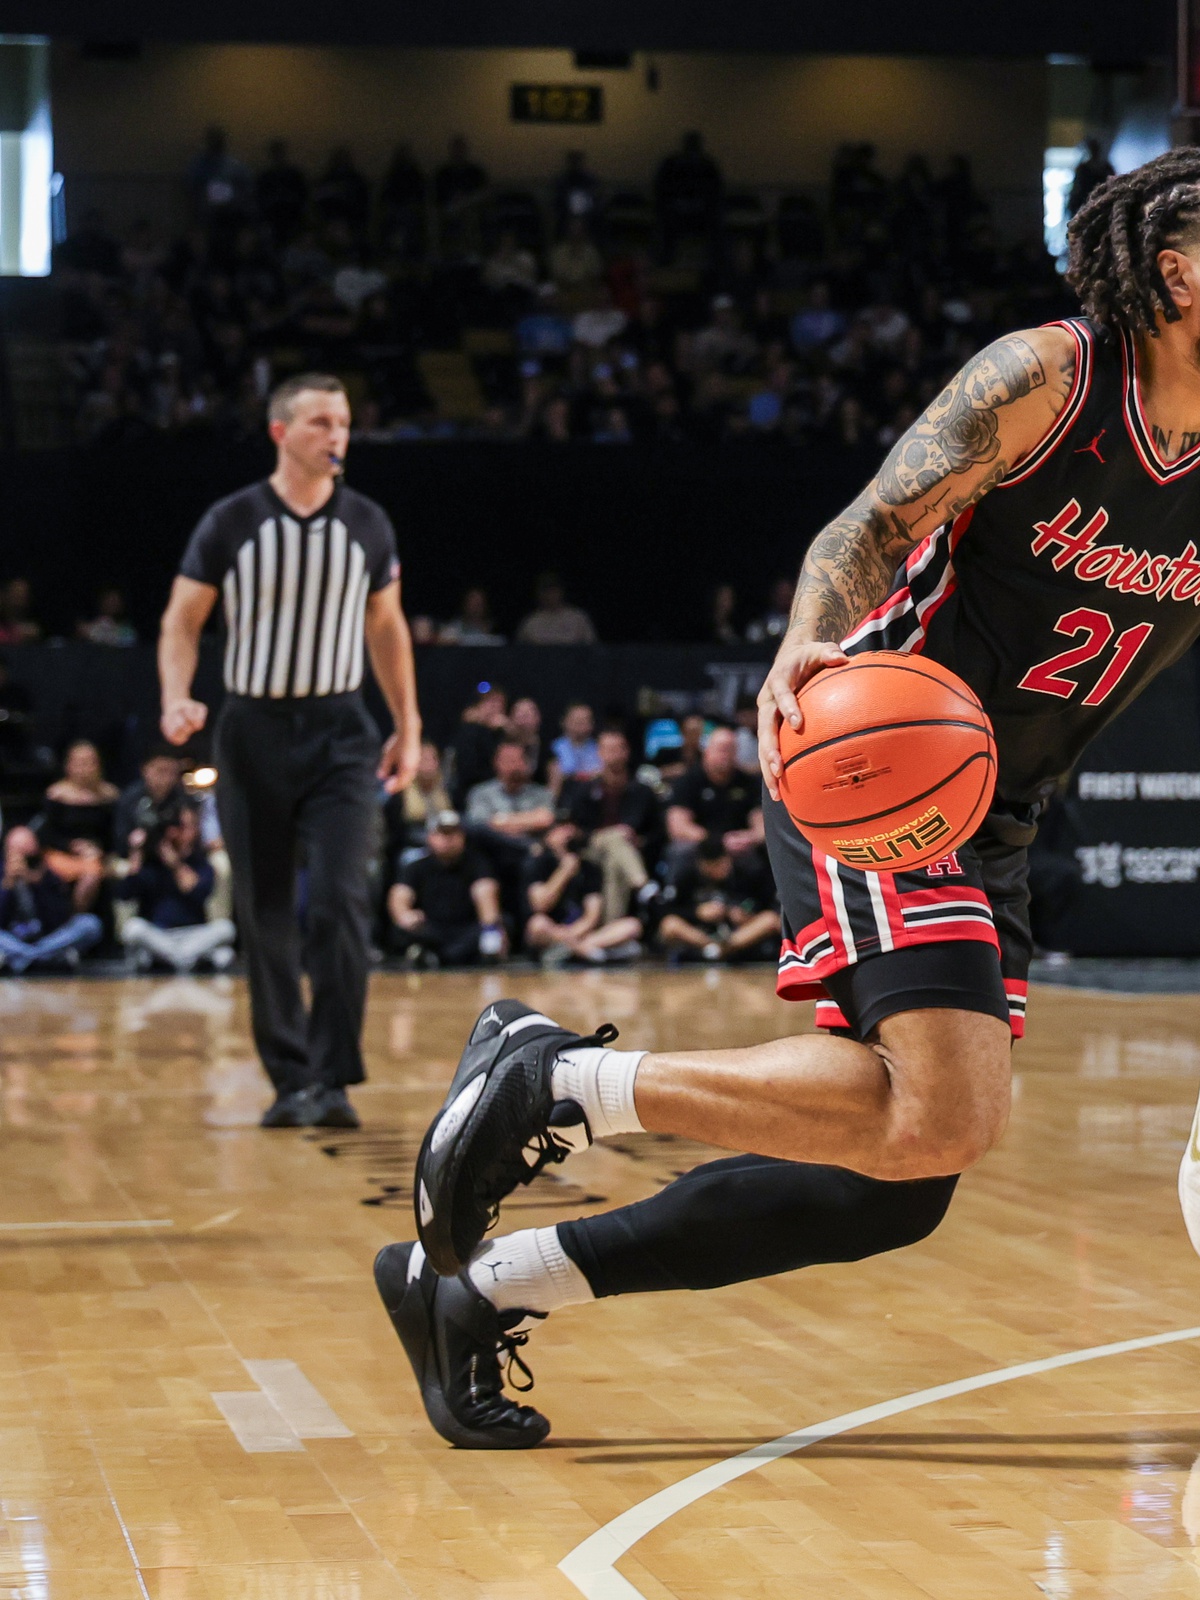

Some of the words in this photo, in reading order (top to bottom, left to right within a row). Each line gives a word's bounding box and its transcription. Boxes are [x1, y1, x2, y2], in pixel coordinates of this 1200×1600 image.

[1017, 607, 1154, 706] 21
[832, 806, 939, 846] CHAMPIONSHIP
[837, 811, 952, 864] ELITE
